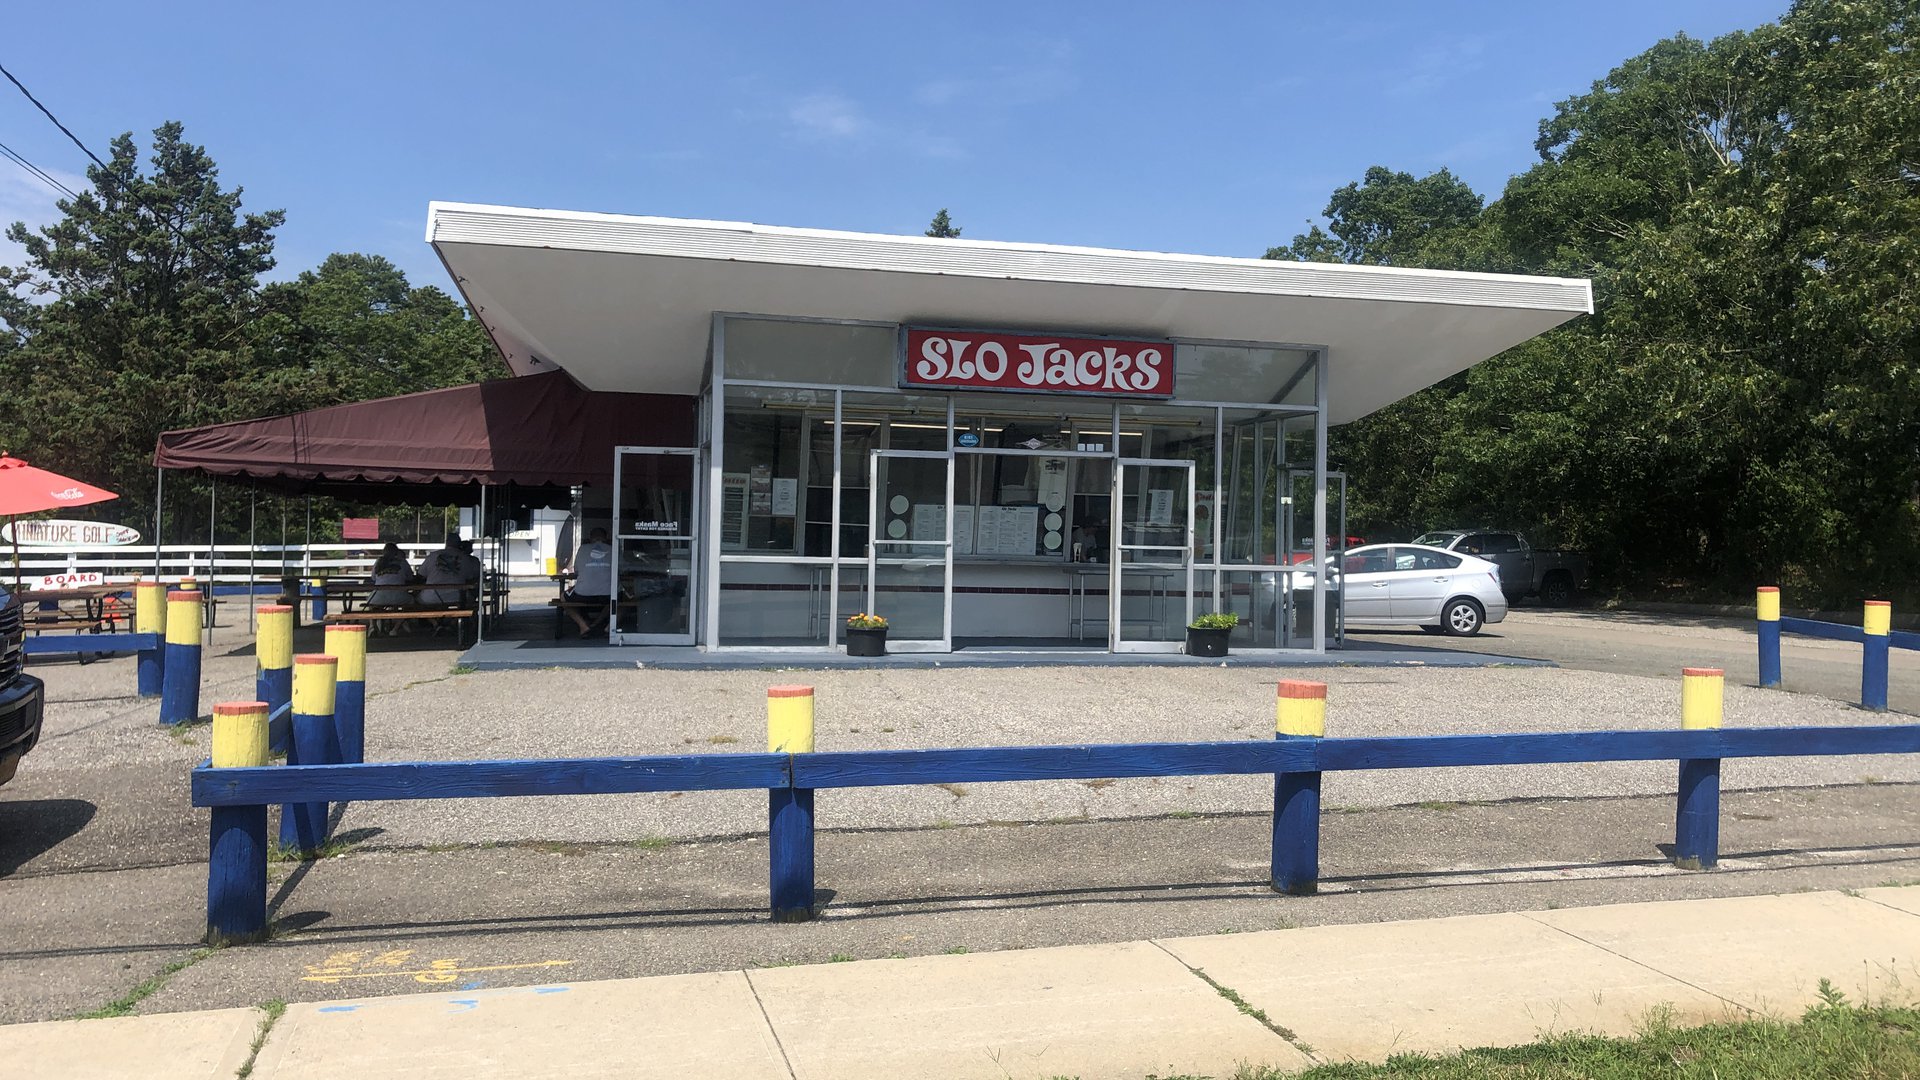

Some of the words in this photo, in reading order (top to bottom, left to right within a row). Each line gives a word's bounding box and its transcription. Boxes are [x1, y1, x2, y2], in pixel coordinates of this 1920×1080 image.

[1017, 343, 1162, 391] Jacks
[83, 525, 115, 543] GOLF
[44, 574, 97, 586] BOARD
